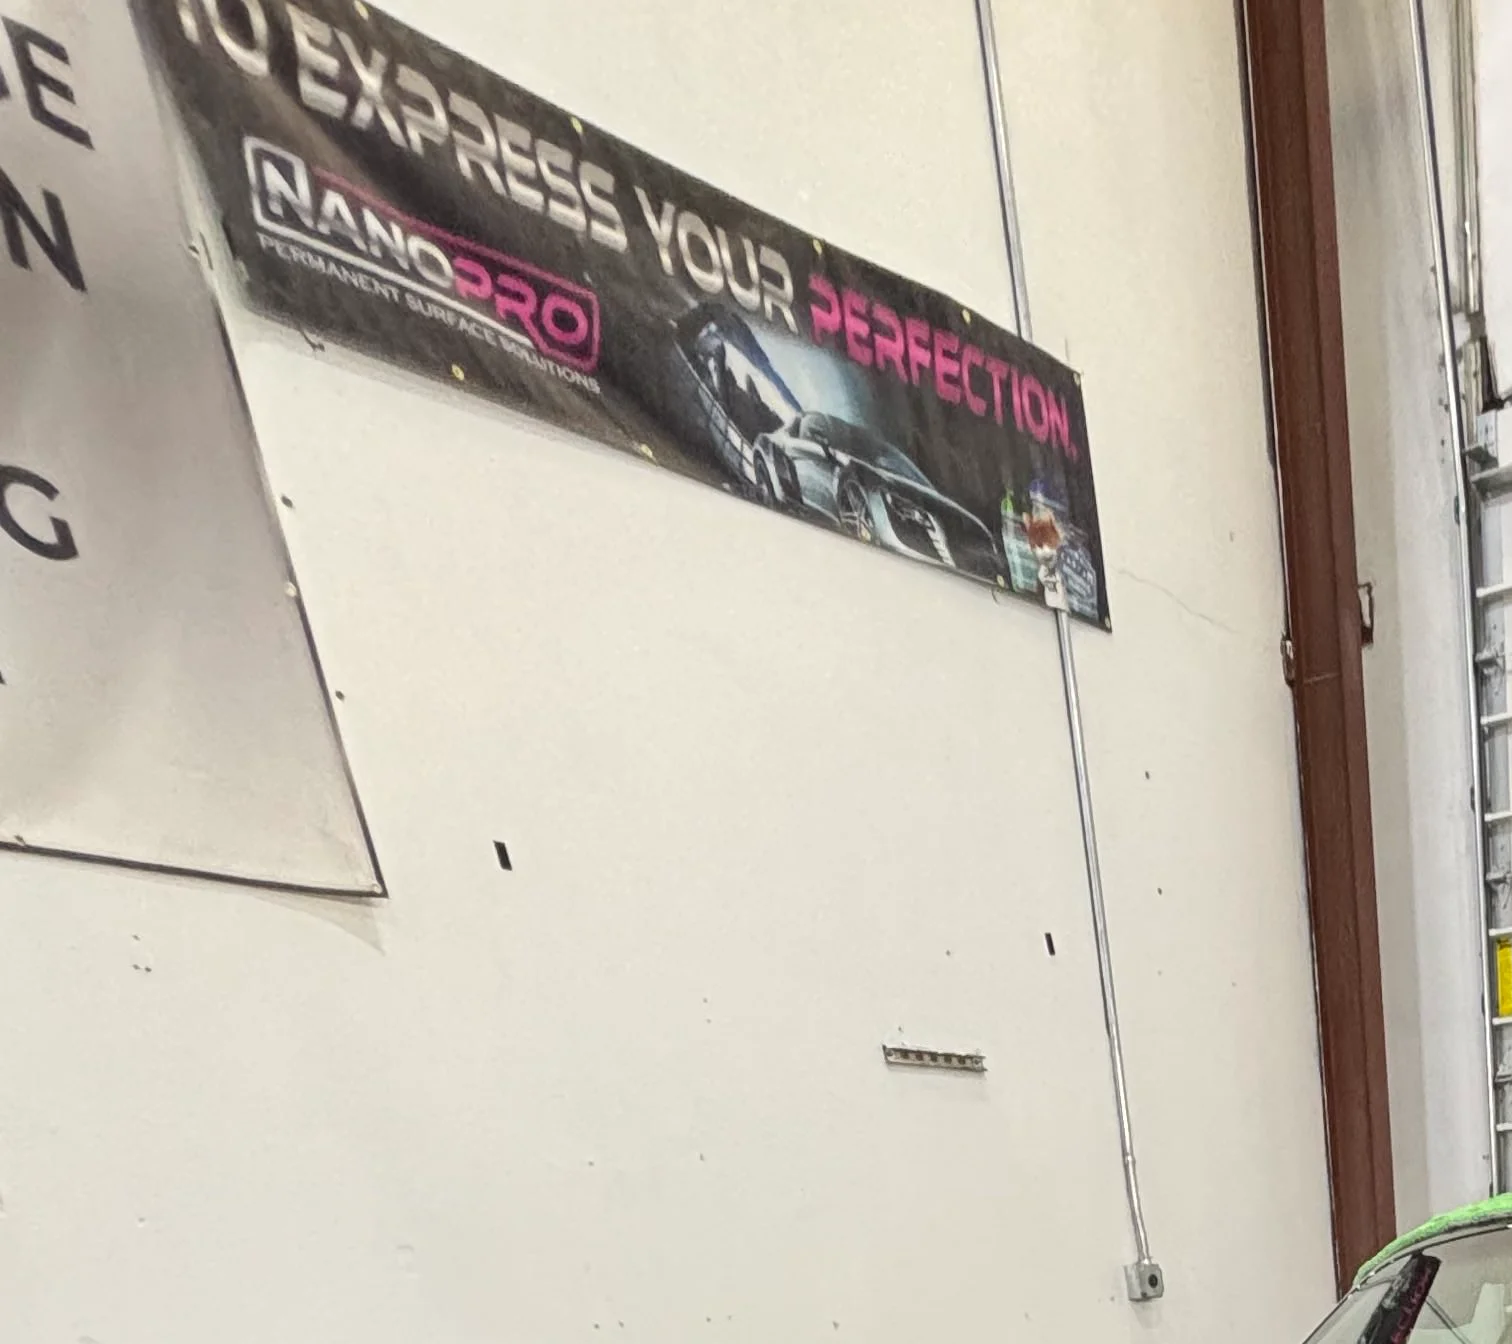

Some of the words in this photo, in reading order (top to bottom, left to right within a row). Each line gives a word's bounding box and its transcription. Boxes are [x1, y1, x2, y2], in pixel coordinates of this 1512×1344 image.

[0, 15, 95, 150] E
[285, 0, 628, 253] EXPRESS
[633, 186, 797, 333] YOUR
[256, 231, 400, 303] PERMANENT
[405, 291, 501, 347] SURFACE
[500, 335, 601, 395] SOLUTIONS
[260, 145, 590, 345] NANOPRO
